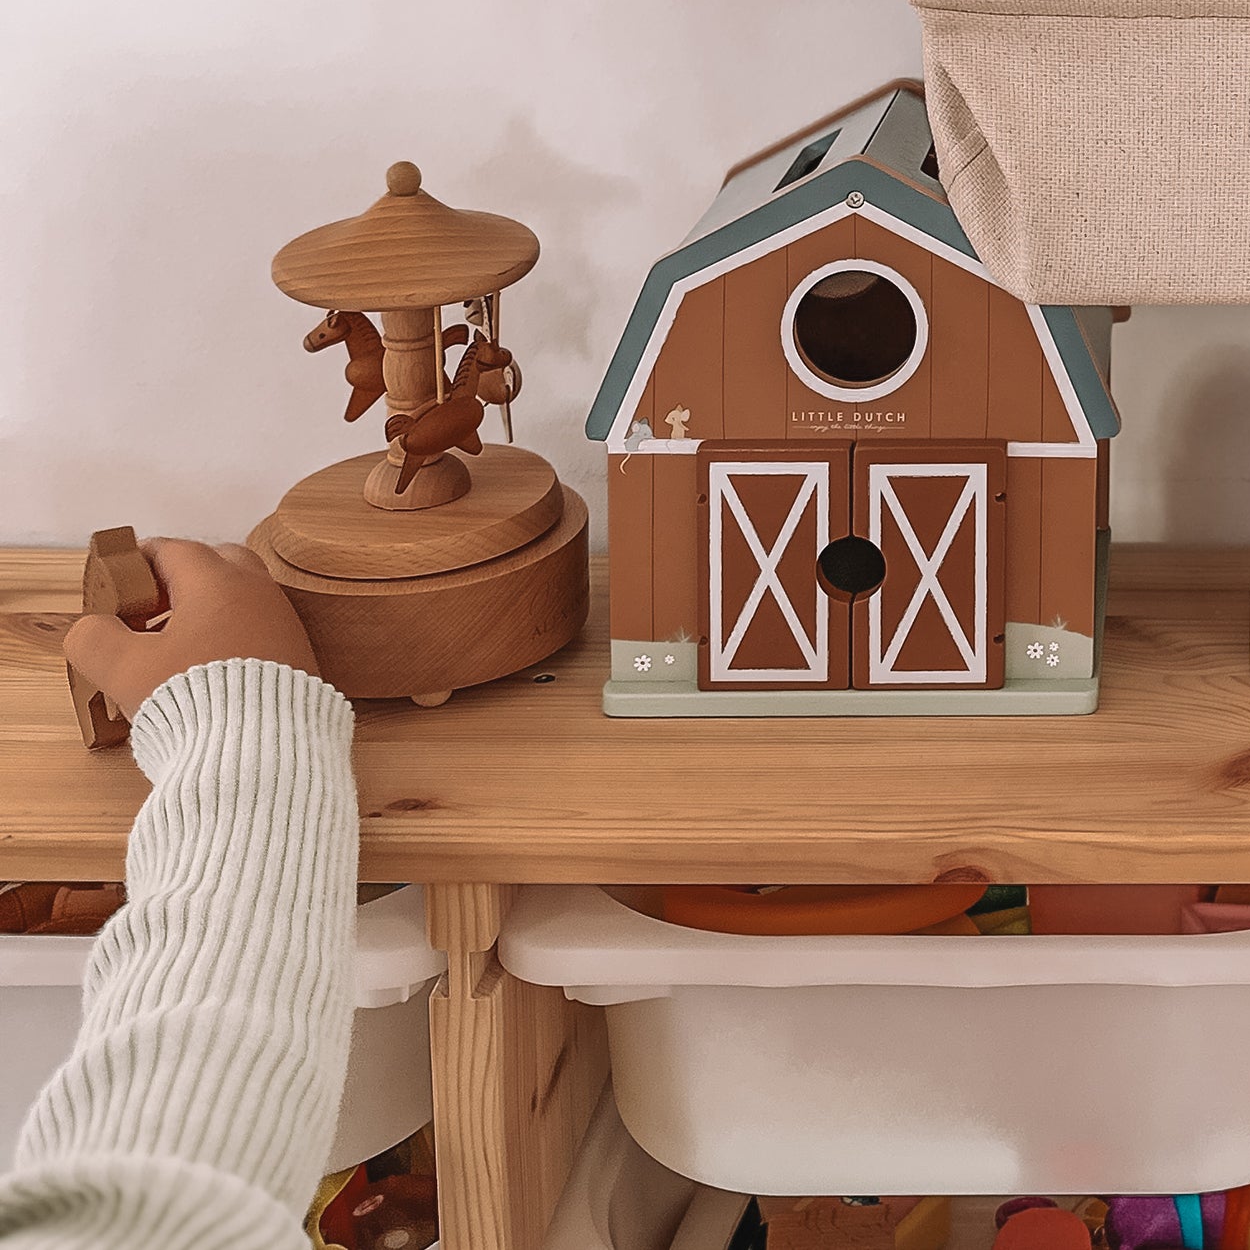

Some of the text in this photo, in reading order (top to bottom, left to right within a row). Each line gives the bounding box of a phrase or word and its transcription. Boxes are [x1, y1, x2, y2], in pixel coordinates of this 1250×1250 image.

[791, 411, 906, 422] LITTLE DUTCH
[808, 424, 829, 433] enjoy
